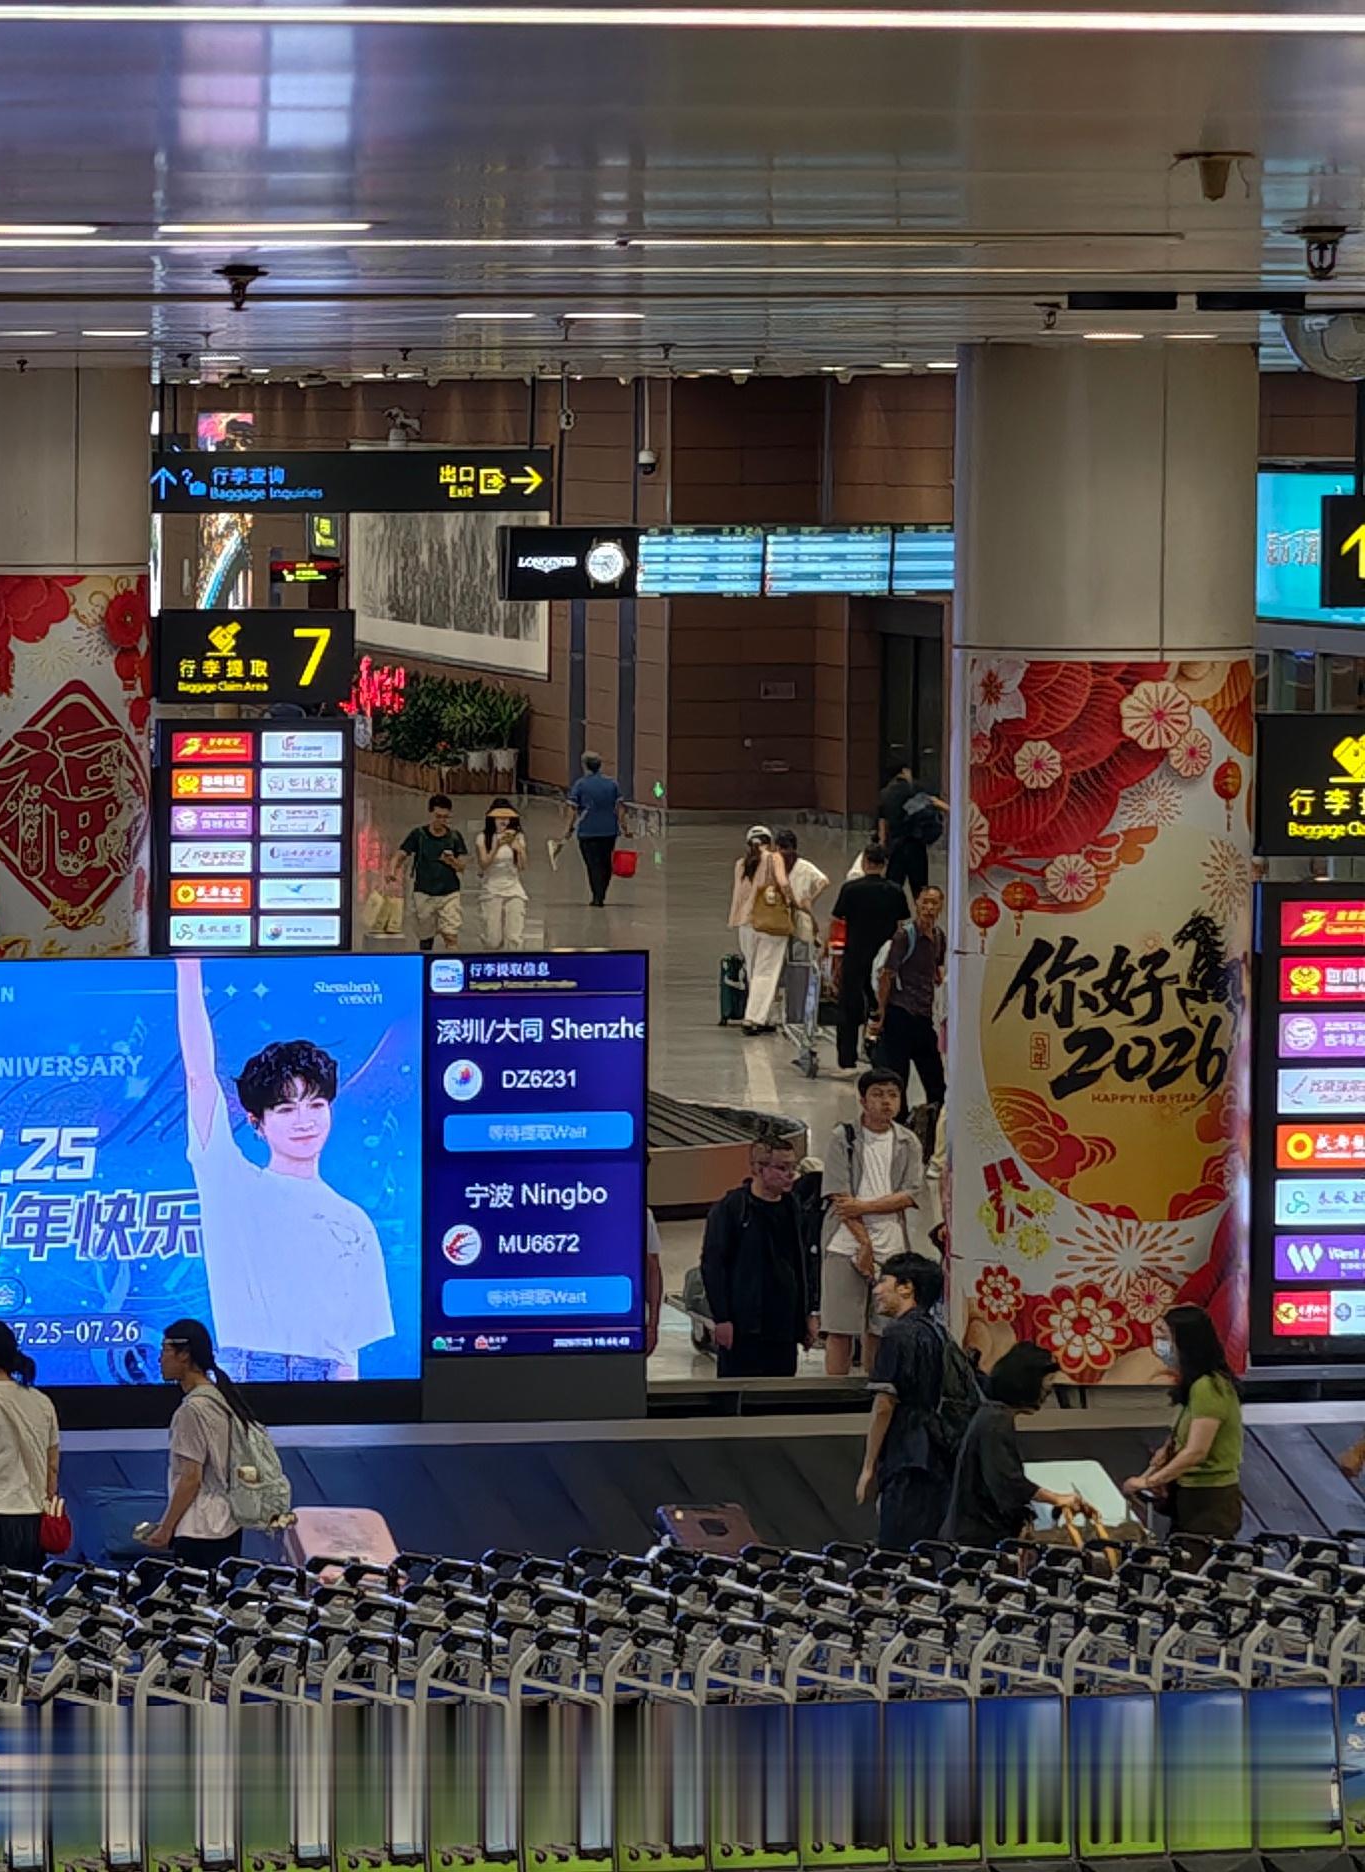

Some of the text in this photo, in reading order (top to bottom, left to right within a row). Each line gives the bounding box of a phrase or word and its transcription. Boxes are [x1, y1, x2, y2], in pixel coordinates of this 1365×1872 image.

[211, 465, 476, 485] 行李查询 出口
[209, 486, 267, 501] Baggage
[448, 485, 475, 498] Exit
[293, 627, 331, 687] 7
[178, 658, 269, 679] 行李提取
[1288, 821, 1346, 840] Baggage
[436, 1017, 544, 1045] 深圳/大同
[1049, 1014, 1229, 1104] 2026
[502, 1069, 577, 1089] DZ6231
[465, 1180, 608, 1211] 宁波 Ningbo
[498, 1234, 580, 1254] MU6672
[12, 1320, 141, 1345] 7.25-07.26
